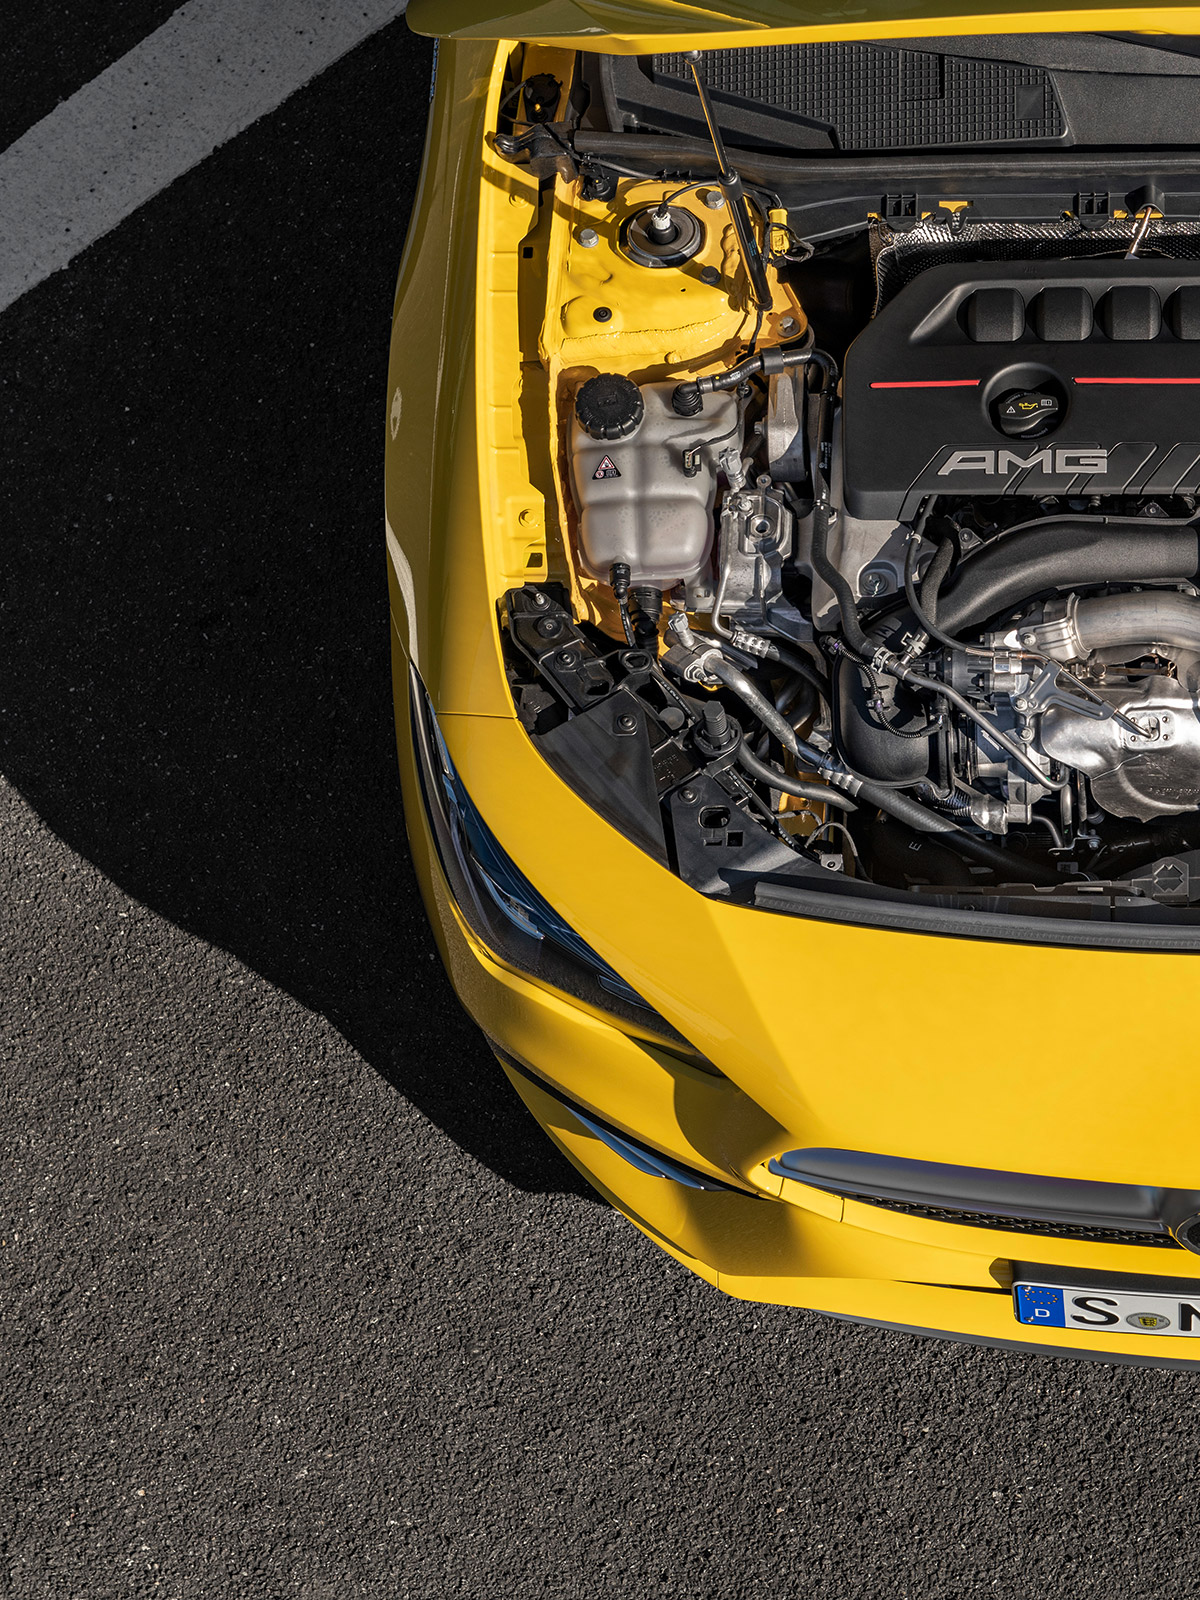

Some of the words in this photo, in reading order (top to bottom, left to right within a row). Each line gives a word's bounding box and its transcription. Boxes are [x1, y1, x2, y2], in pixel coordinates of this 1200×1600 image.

[937, 449, 1108, 475] AMG
[1034, 1308, 1051, 1318] D
[1071, 1296, 1120, 1326] S
